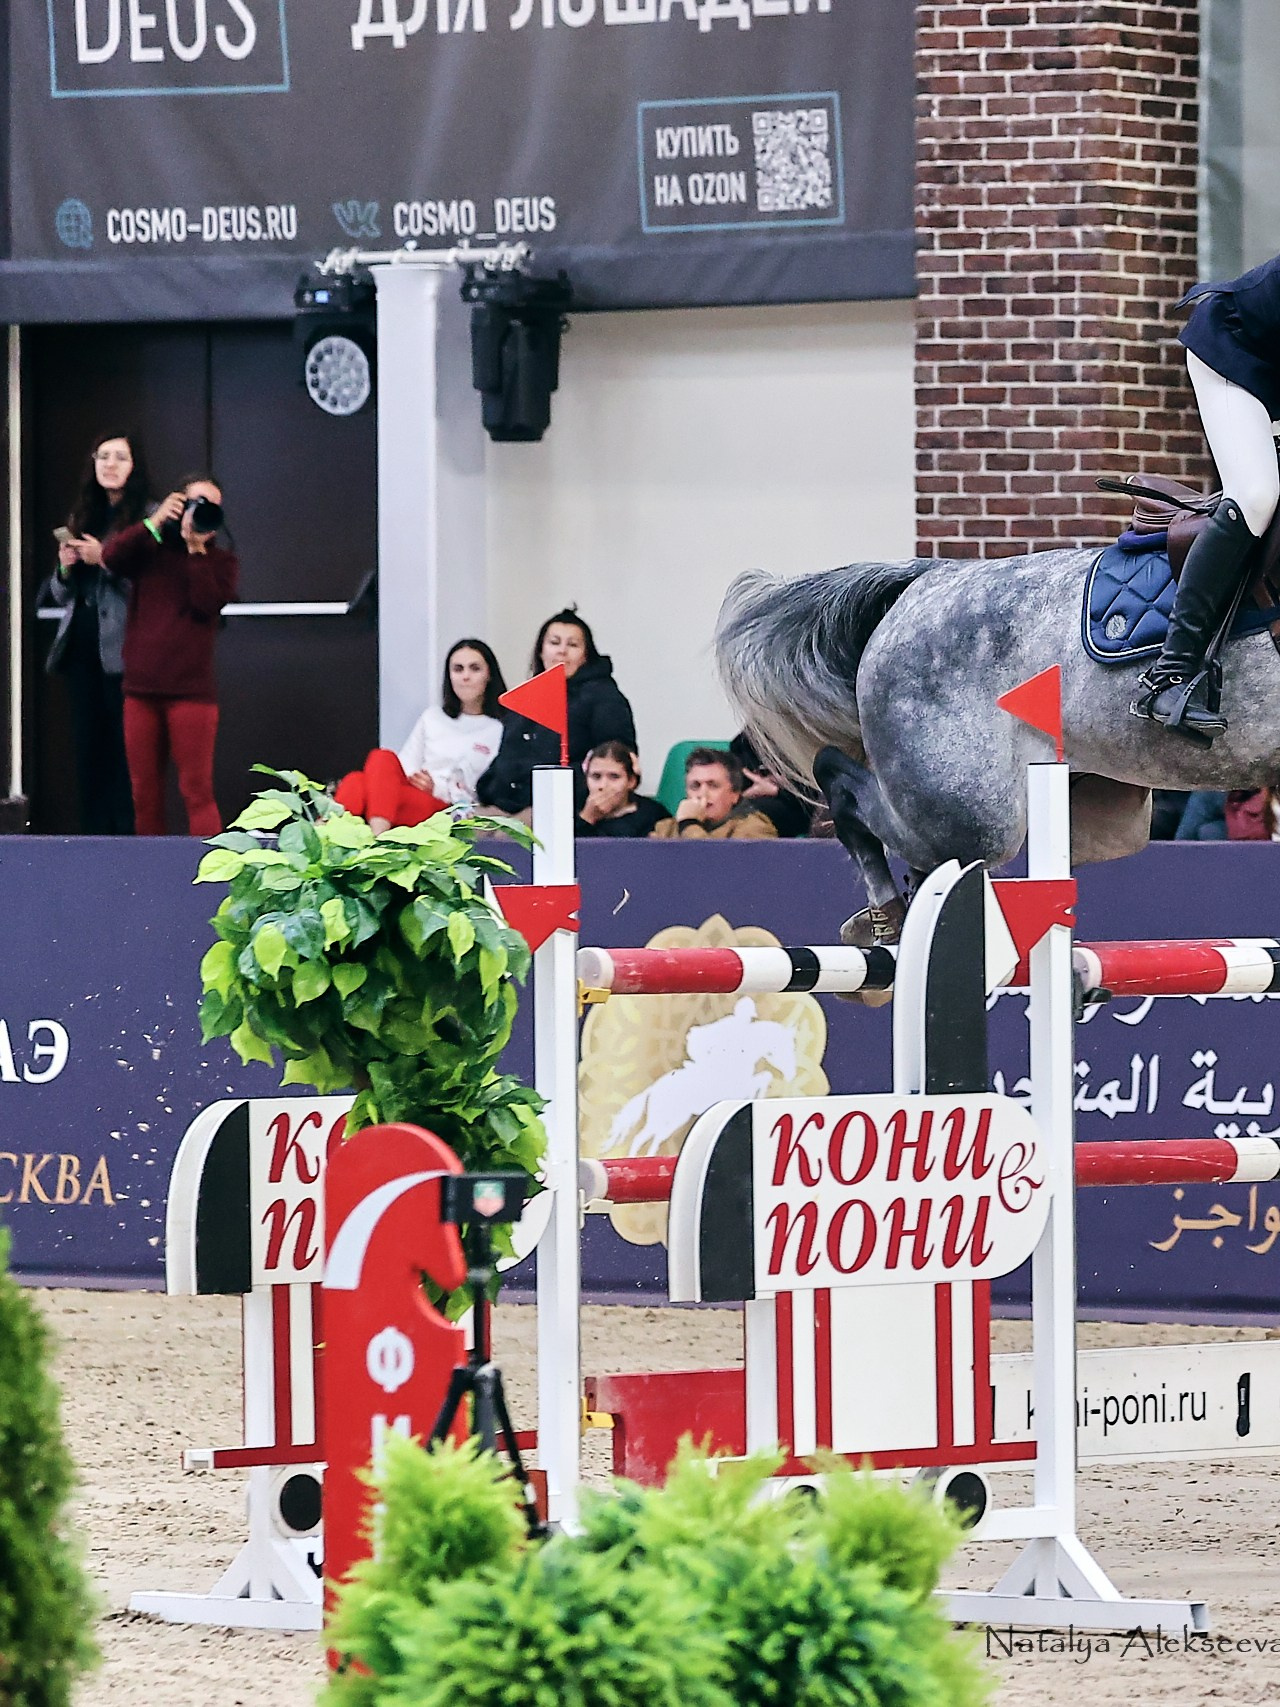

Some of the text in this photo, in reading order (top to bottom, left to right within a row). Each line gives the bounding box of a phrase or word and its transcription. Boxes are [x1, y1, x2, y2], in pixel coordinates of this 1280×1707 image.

[75, 0, 257, 63] DEUS
[655, 124, 740, 160] КУПИТЬ
[654, 171, 747, 207] НА OZON
[106, 204, 298, 244] COSMO-DEUS.RU
[393, 196, 557, 240] COSMO_DEUS
